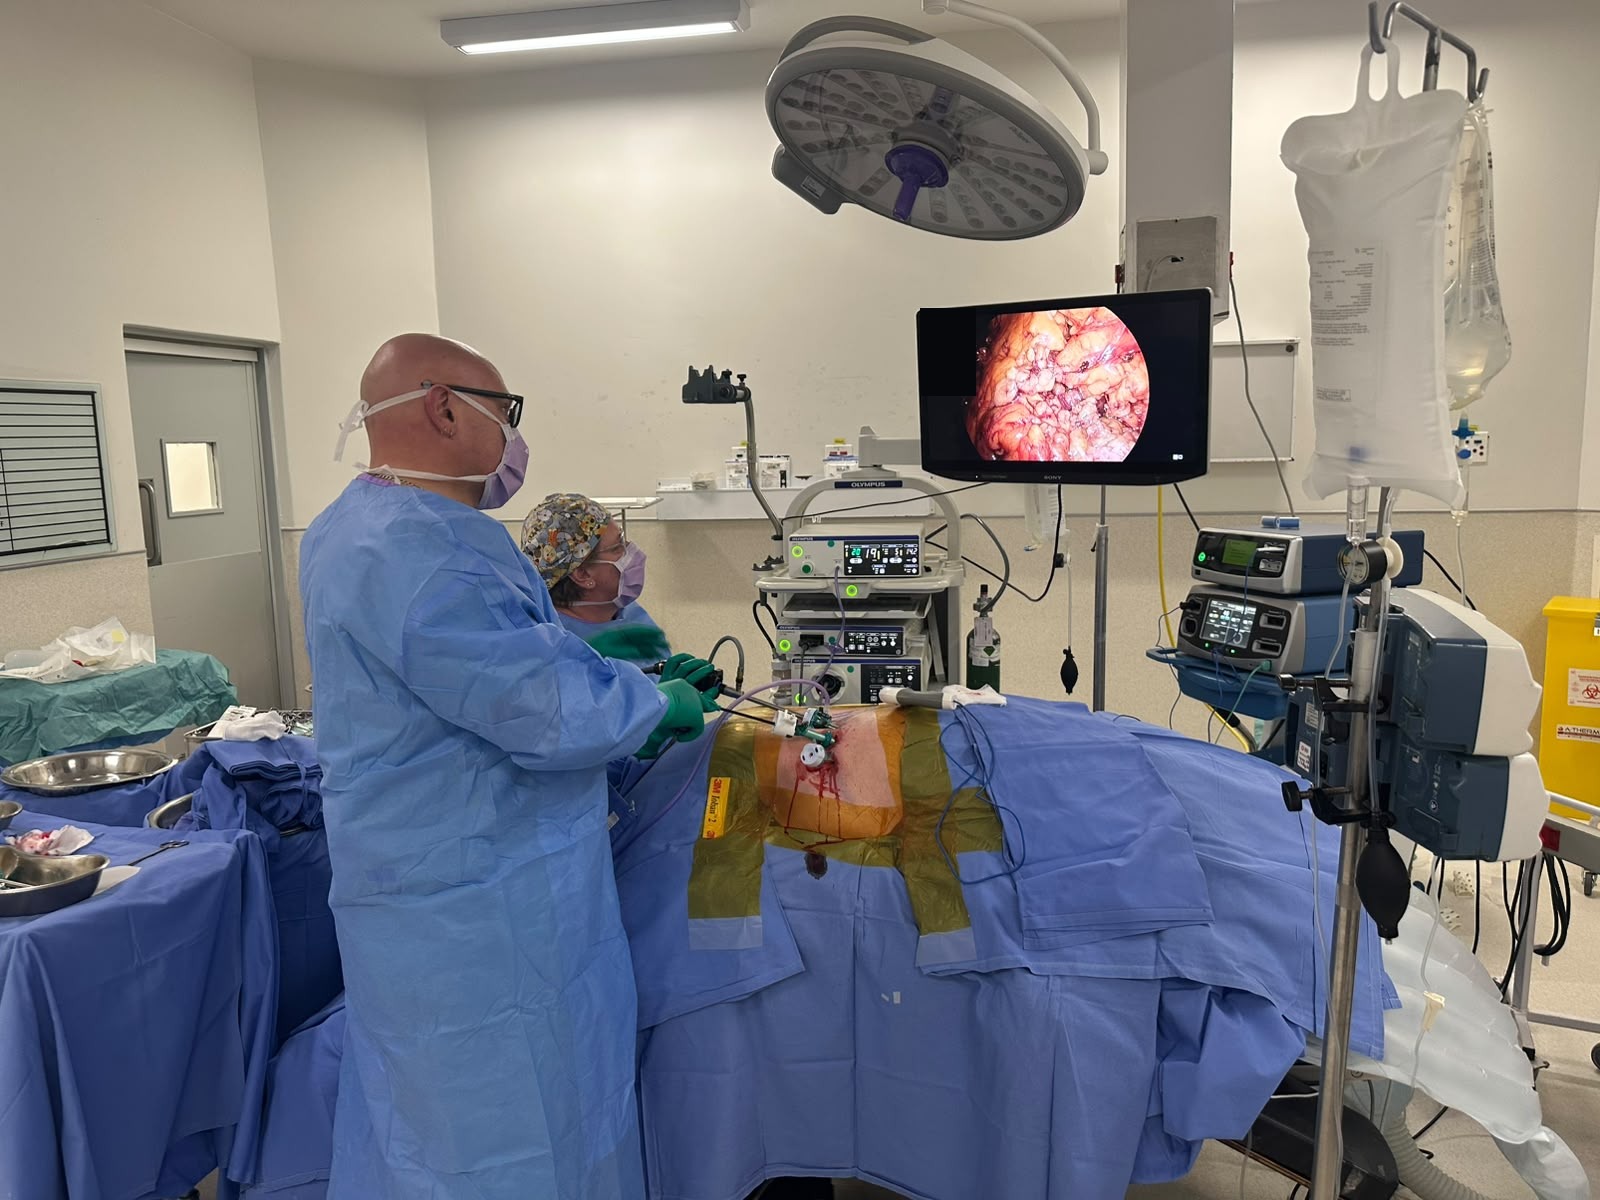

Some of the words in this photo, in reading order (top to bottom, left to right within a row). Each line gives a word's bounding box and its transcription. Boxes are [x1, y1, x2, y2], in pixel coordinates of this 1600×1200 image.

[851, 548, 861, 556] 20
[865, 548, 877, 559] 19
[712, 779, 722, 794] 3M
